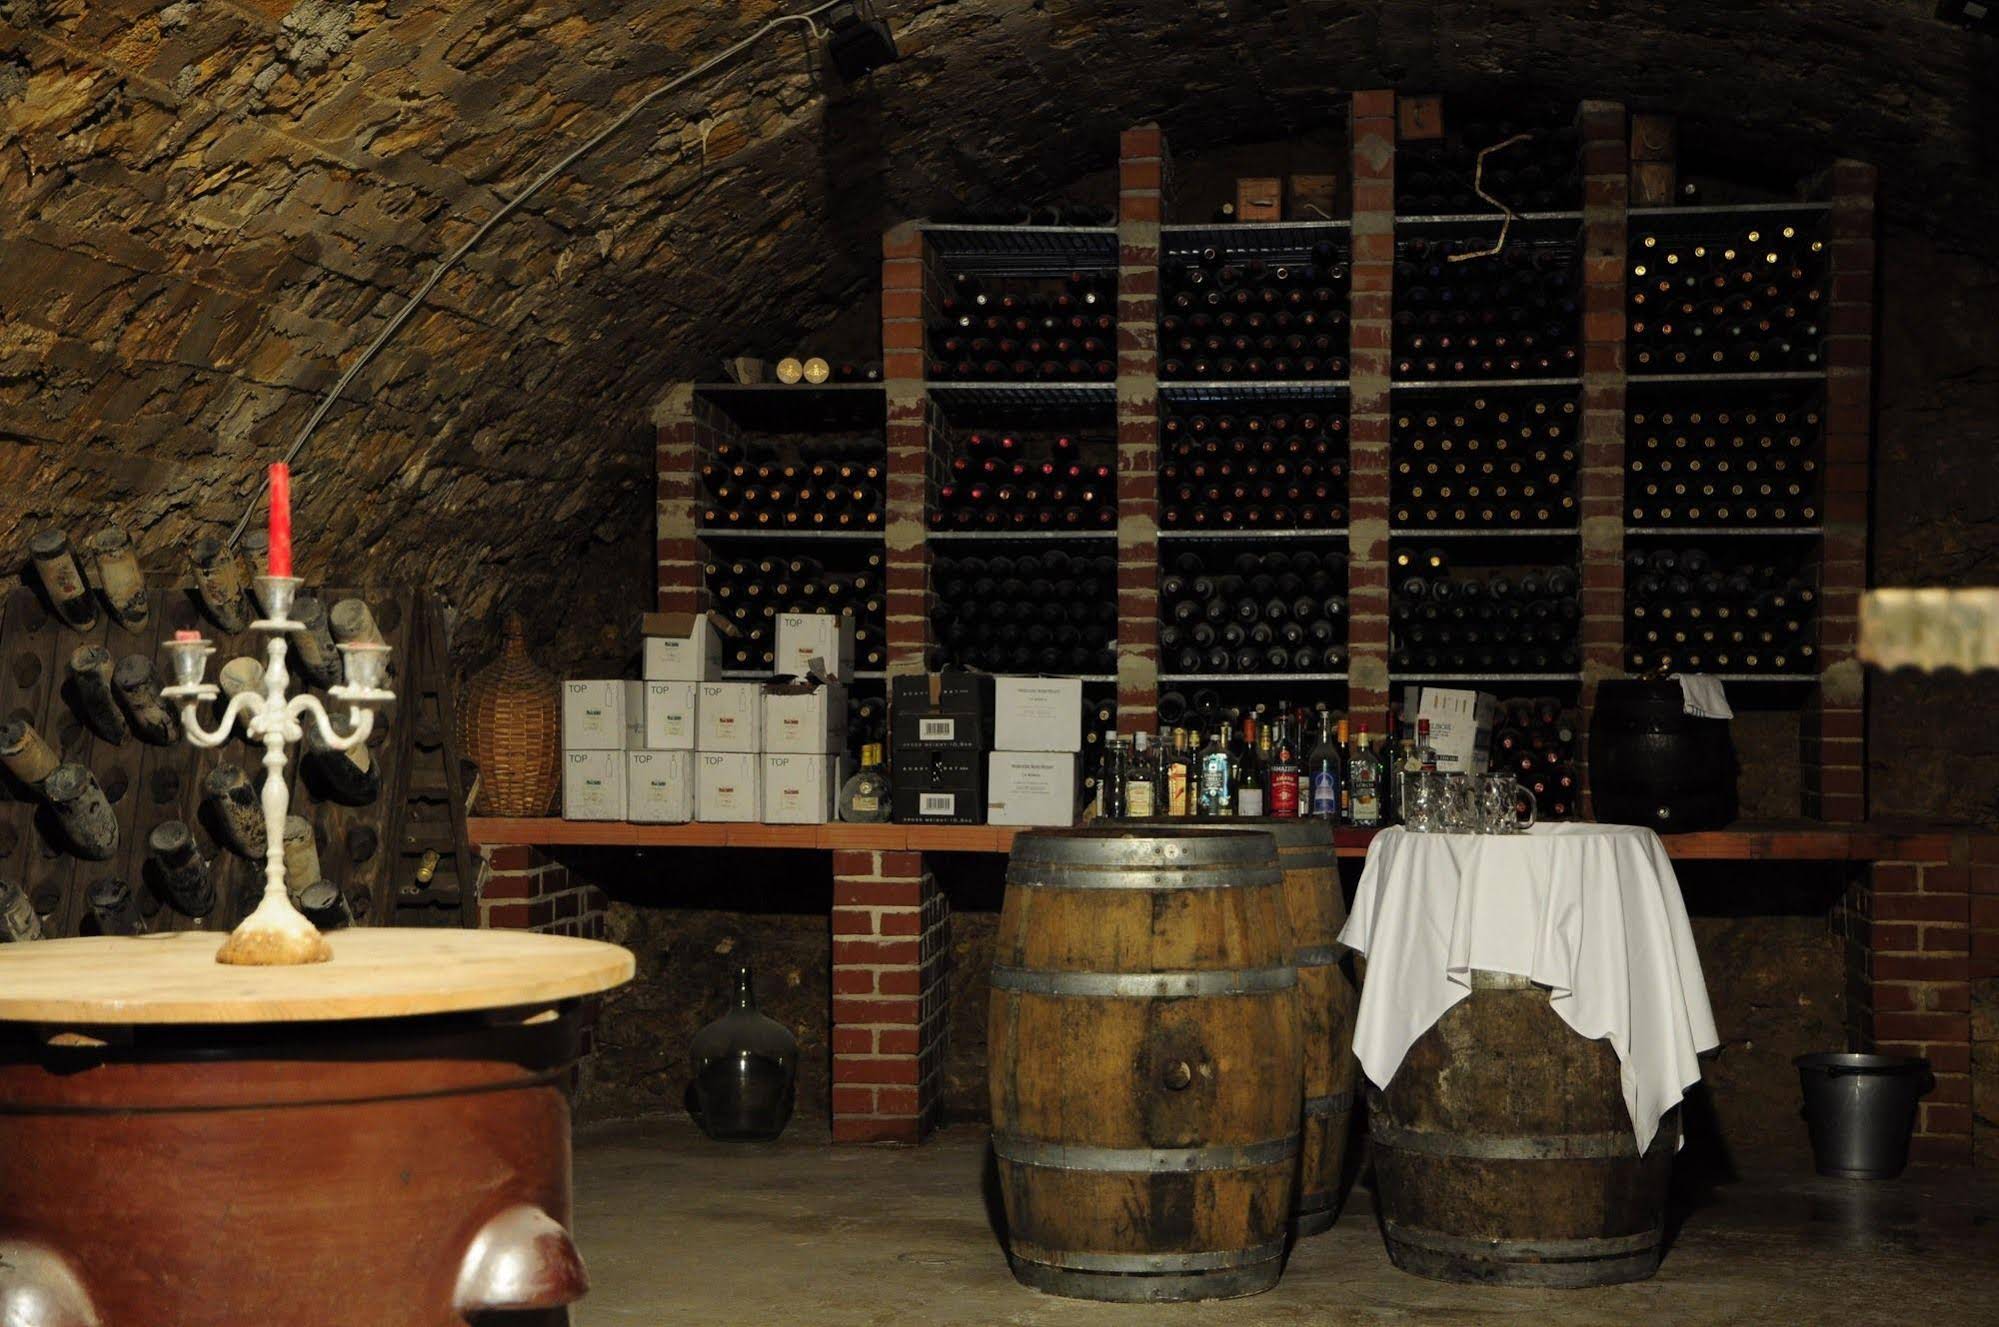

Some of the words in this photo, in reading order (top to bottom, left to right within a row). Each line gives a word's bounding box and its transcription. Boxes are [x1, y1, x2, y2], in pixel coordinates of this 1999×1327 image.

[784, 618, 803, 628] TOP
[569, 685, 588, 693] TOP
[651, 686, 670, 695] TOP
[704, 688, 722, 696] TOP
[569, 755, 588, 763] TOP
[633, 755, 653, 764] TOP
[704, 757, 723, 765] TOP
[771, 758, 789, 767] TOP
